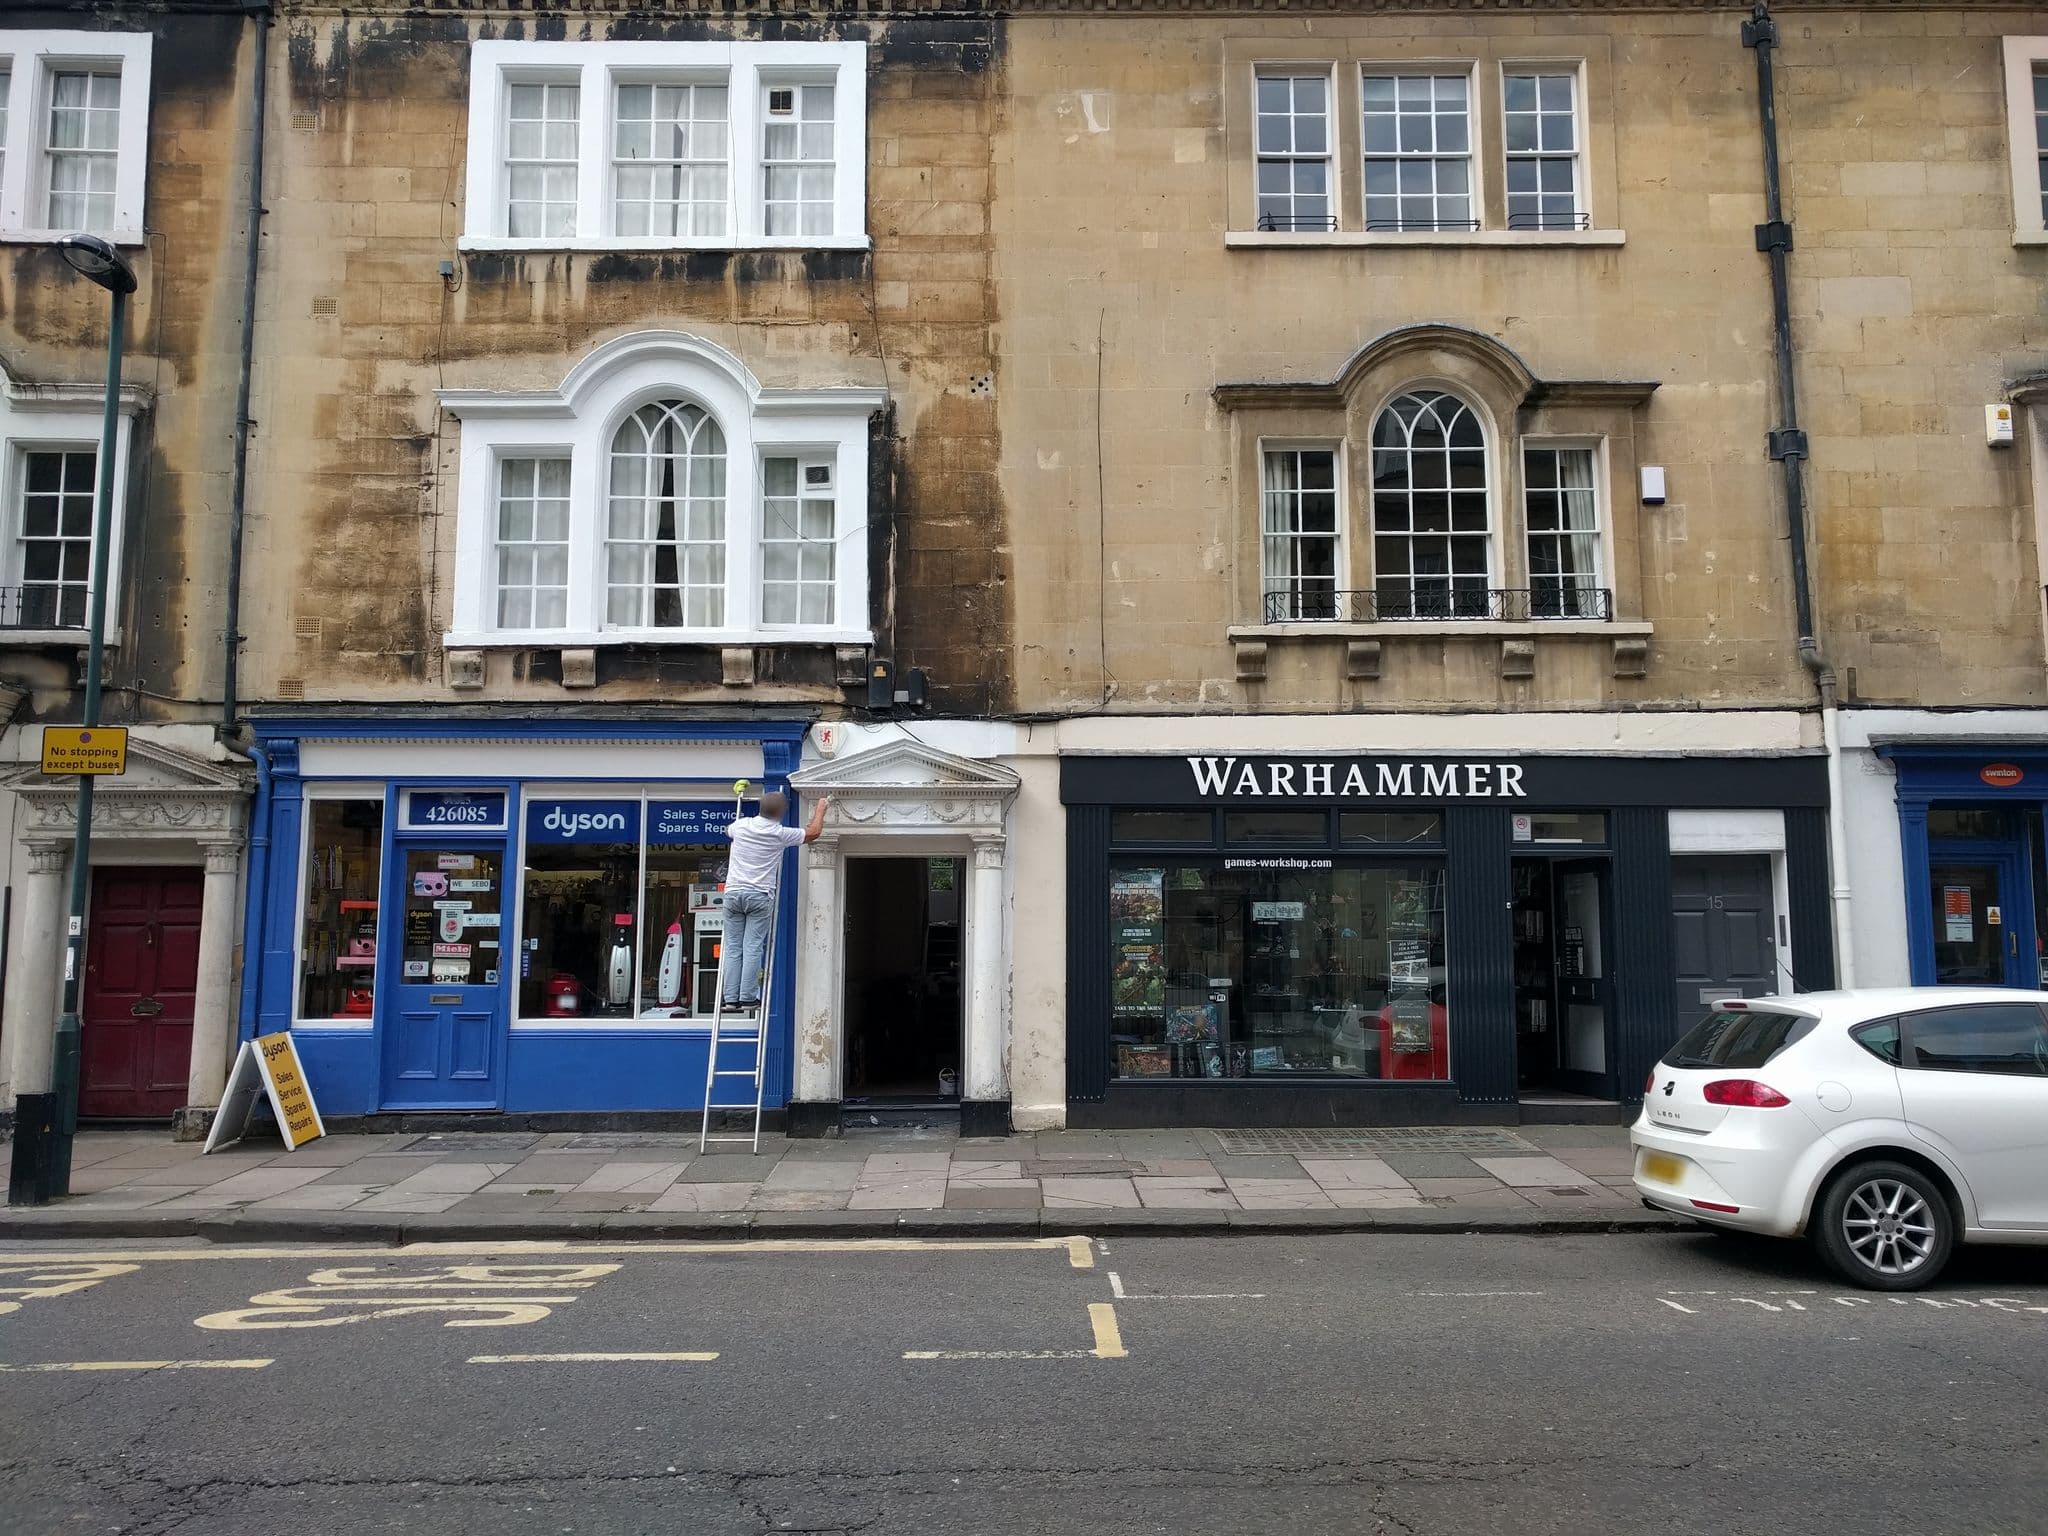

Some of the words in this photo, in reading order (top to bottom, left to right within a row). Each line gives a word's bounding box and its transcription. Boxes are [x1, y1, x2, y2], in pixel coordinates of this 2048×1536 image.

[50, 747, 66, 757] No
[70, 747, 119, 758] stopping
[47, 761, 84, 770] except
[88, 760, 120, 769] buses
[1187, 757, 1527, 797] WARHAMMER
[1985, 768, 2017, 777] swinton
[426, 806, 488, 821] 426085
[663, 809, 696, 820] Sales
[543, 806, 625, 837] dyson
[658, 822, 700, 834] Spares
[705, 823, 729, 834] Rep
[1224, 857, 1332, 870] games-workshop.com
[451, 880, 463, 888] WE
[1706, 895, 1724, 910] 15
[410, 910, 433, 919] dyson
[70, 921, 77, 930] 6
[435, 945, 469, 953] Miele
[435, 974, 467, 983] OPEN
[262, 1041, 289, 1061] dyson
[276, 1072, 293, 1084] Sales
[279, 1086, 302, 1100] Service
[285, 1101, 306, 1116] Spares
[1656, 1109, 1681, 1120] LEON
[290, 1117, 312, 1132] Repairs
[193, 1263, 625, 1330] BUS
